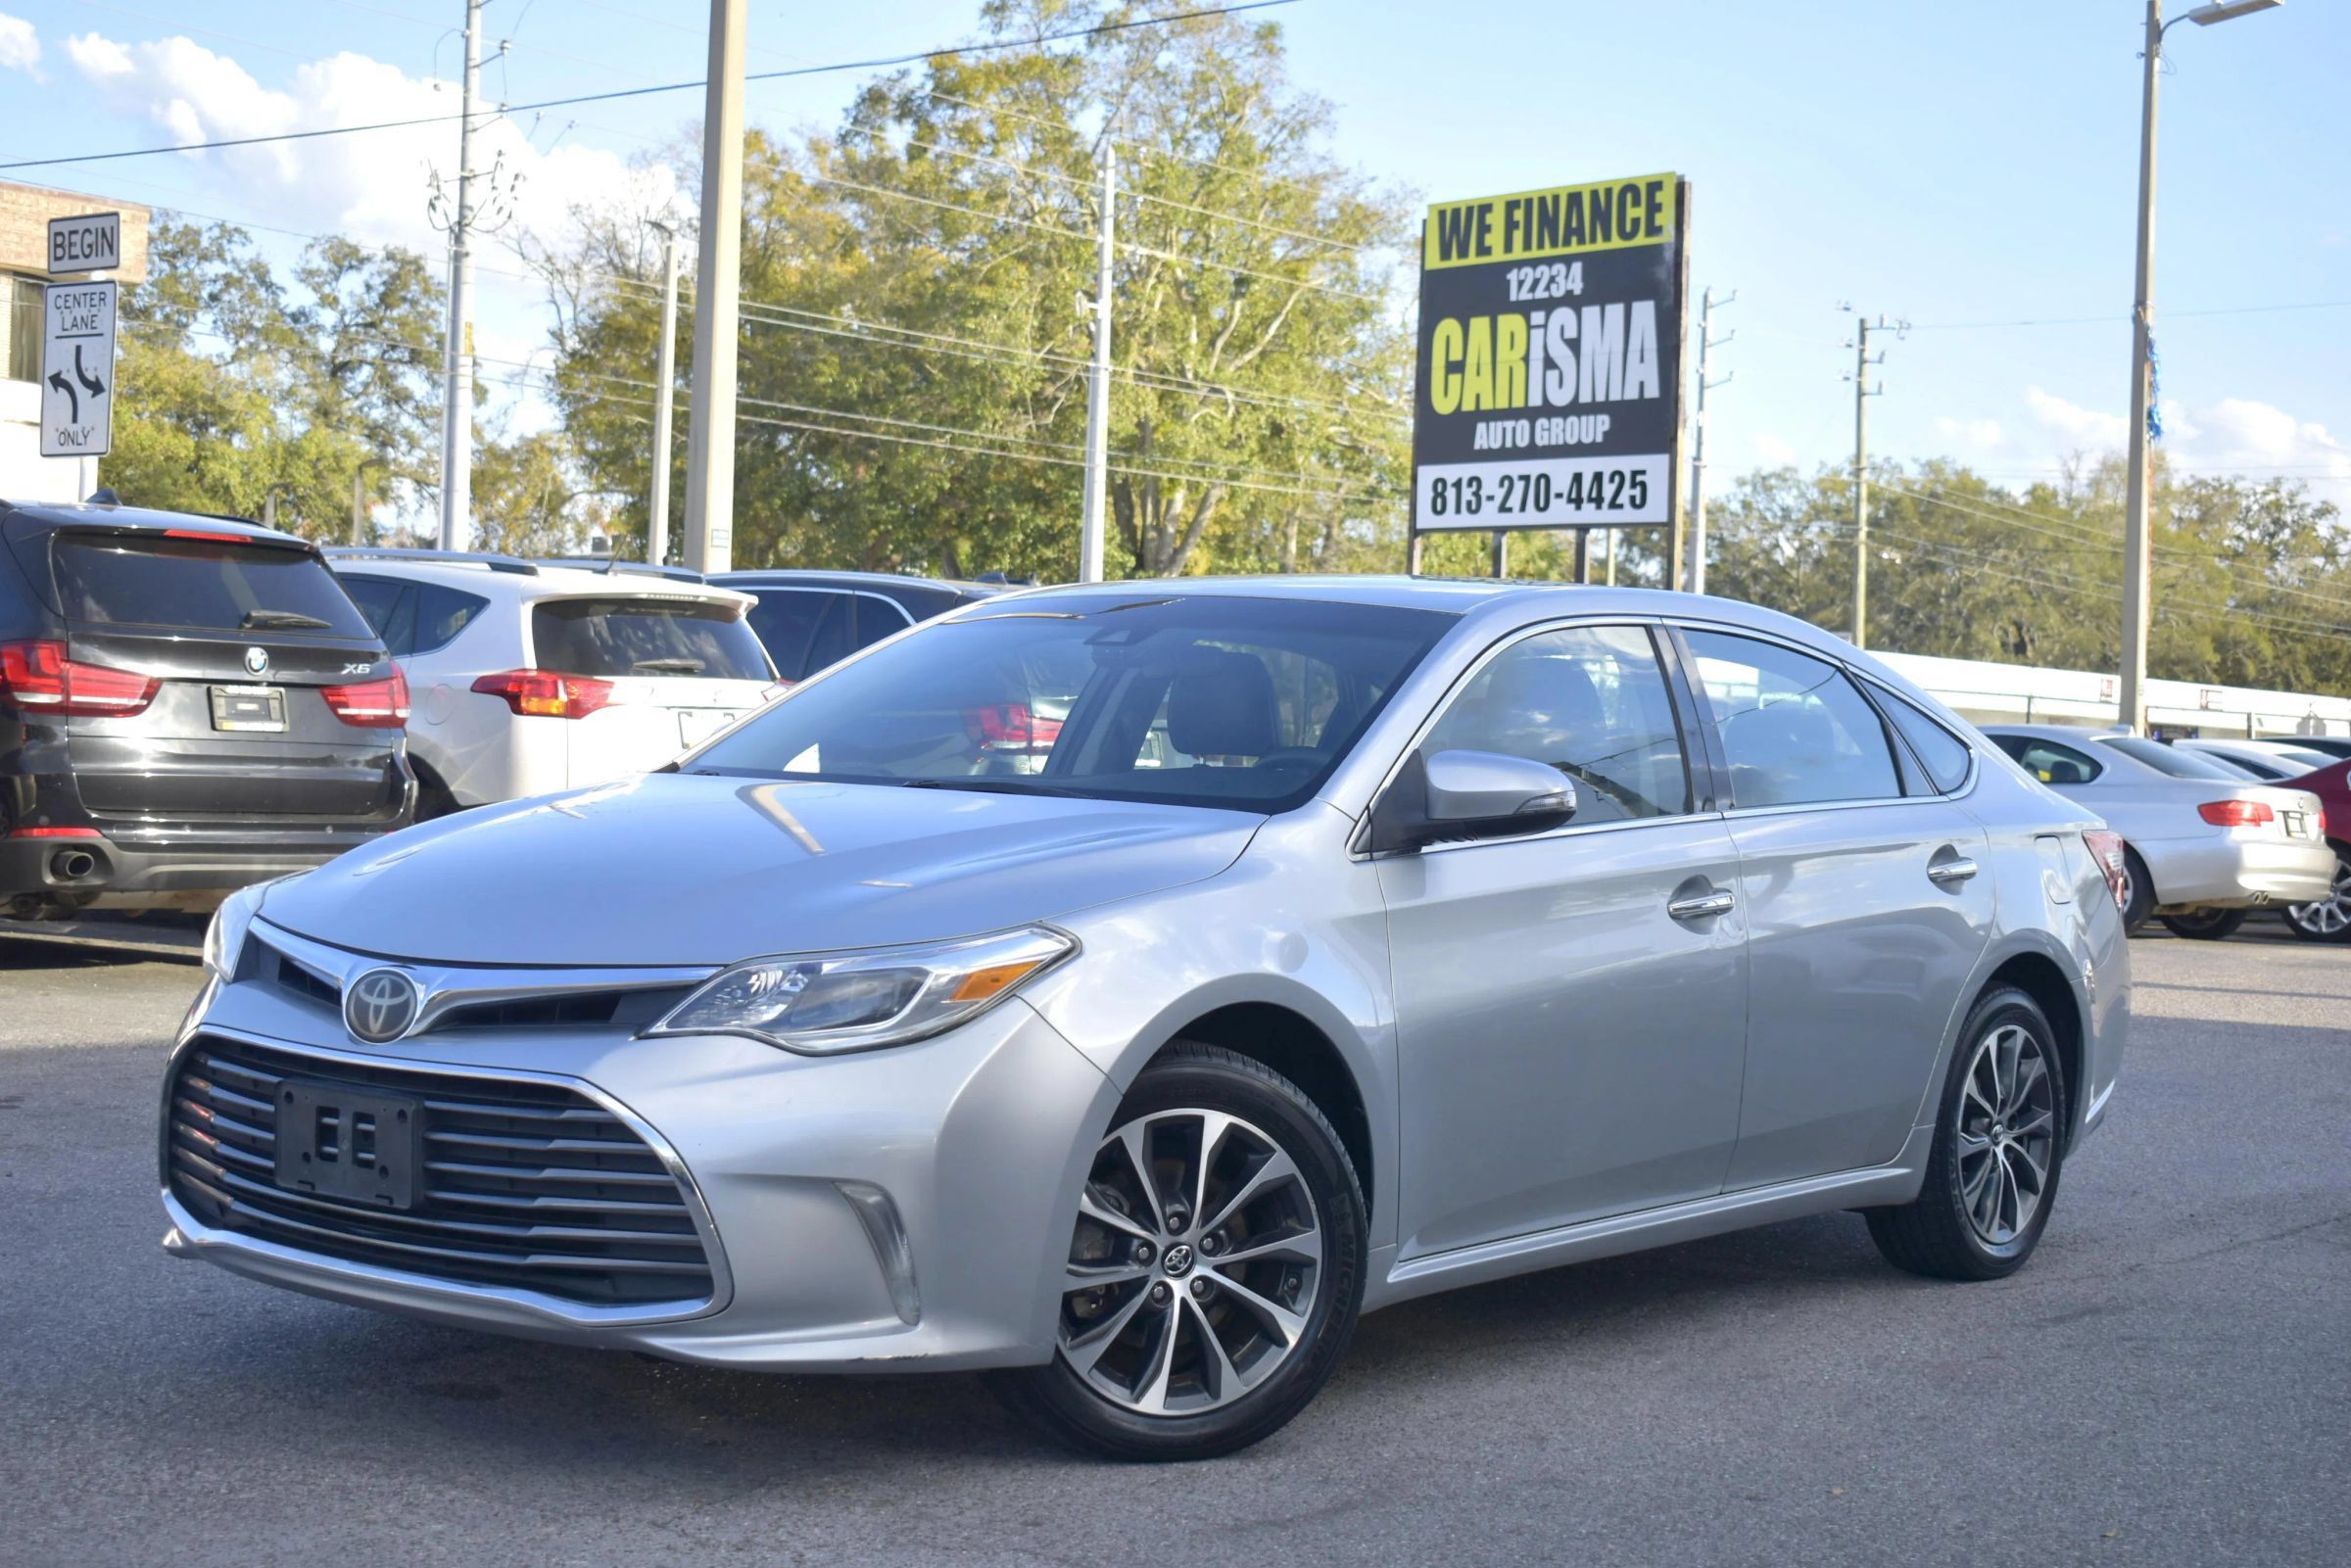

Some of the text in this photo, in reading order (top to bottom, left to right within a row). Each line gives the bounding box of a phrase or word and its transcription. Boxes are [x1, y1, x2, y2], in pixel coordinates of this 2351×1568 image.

[1438, 180, 1663, 261] WE FINANCE
[54, 226, 114, 261] BEGIN
[1507, 261, 1583, 302] 12234
[54, 292, 107, 309] CENTER
[61, 314, 98, 332] LANE
[58, 430, 90, 447] ONLY
[1473, 414, 1610, 451] AUTO GROUP
[1430, 470, 1648, 516] 813-270-4425
